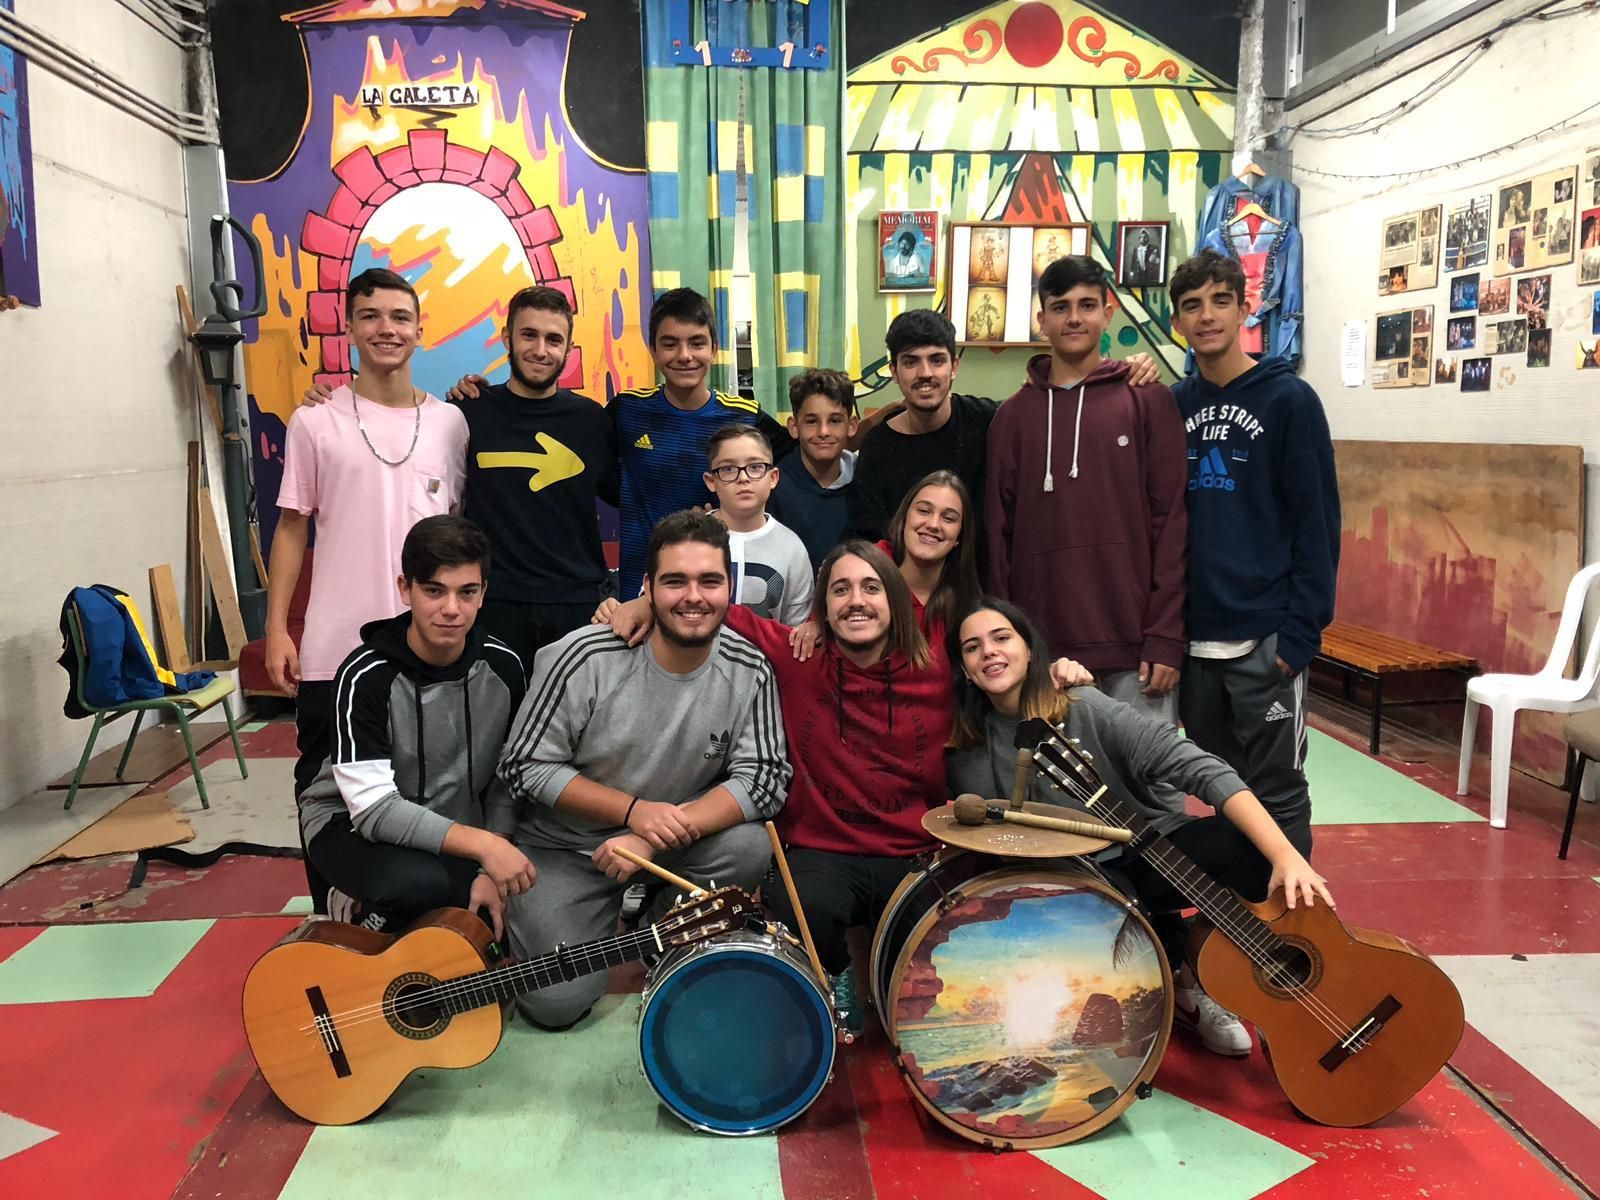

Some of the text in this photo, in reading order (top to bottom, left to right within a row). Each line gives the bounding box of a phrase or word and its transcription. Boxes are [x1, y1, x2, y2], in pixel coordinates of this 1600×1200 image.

[361, 87, 382, 104] LA
[1184, 404, 1264, 440] HREE STRIPE
[1202, 424, 1230, 441] LIFE
[1187, 472, 1235, 492] aidas
